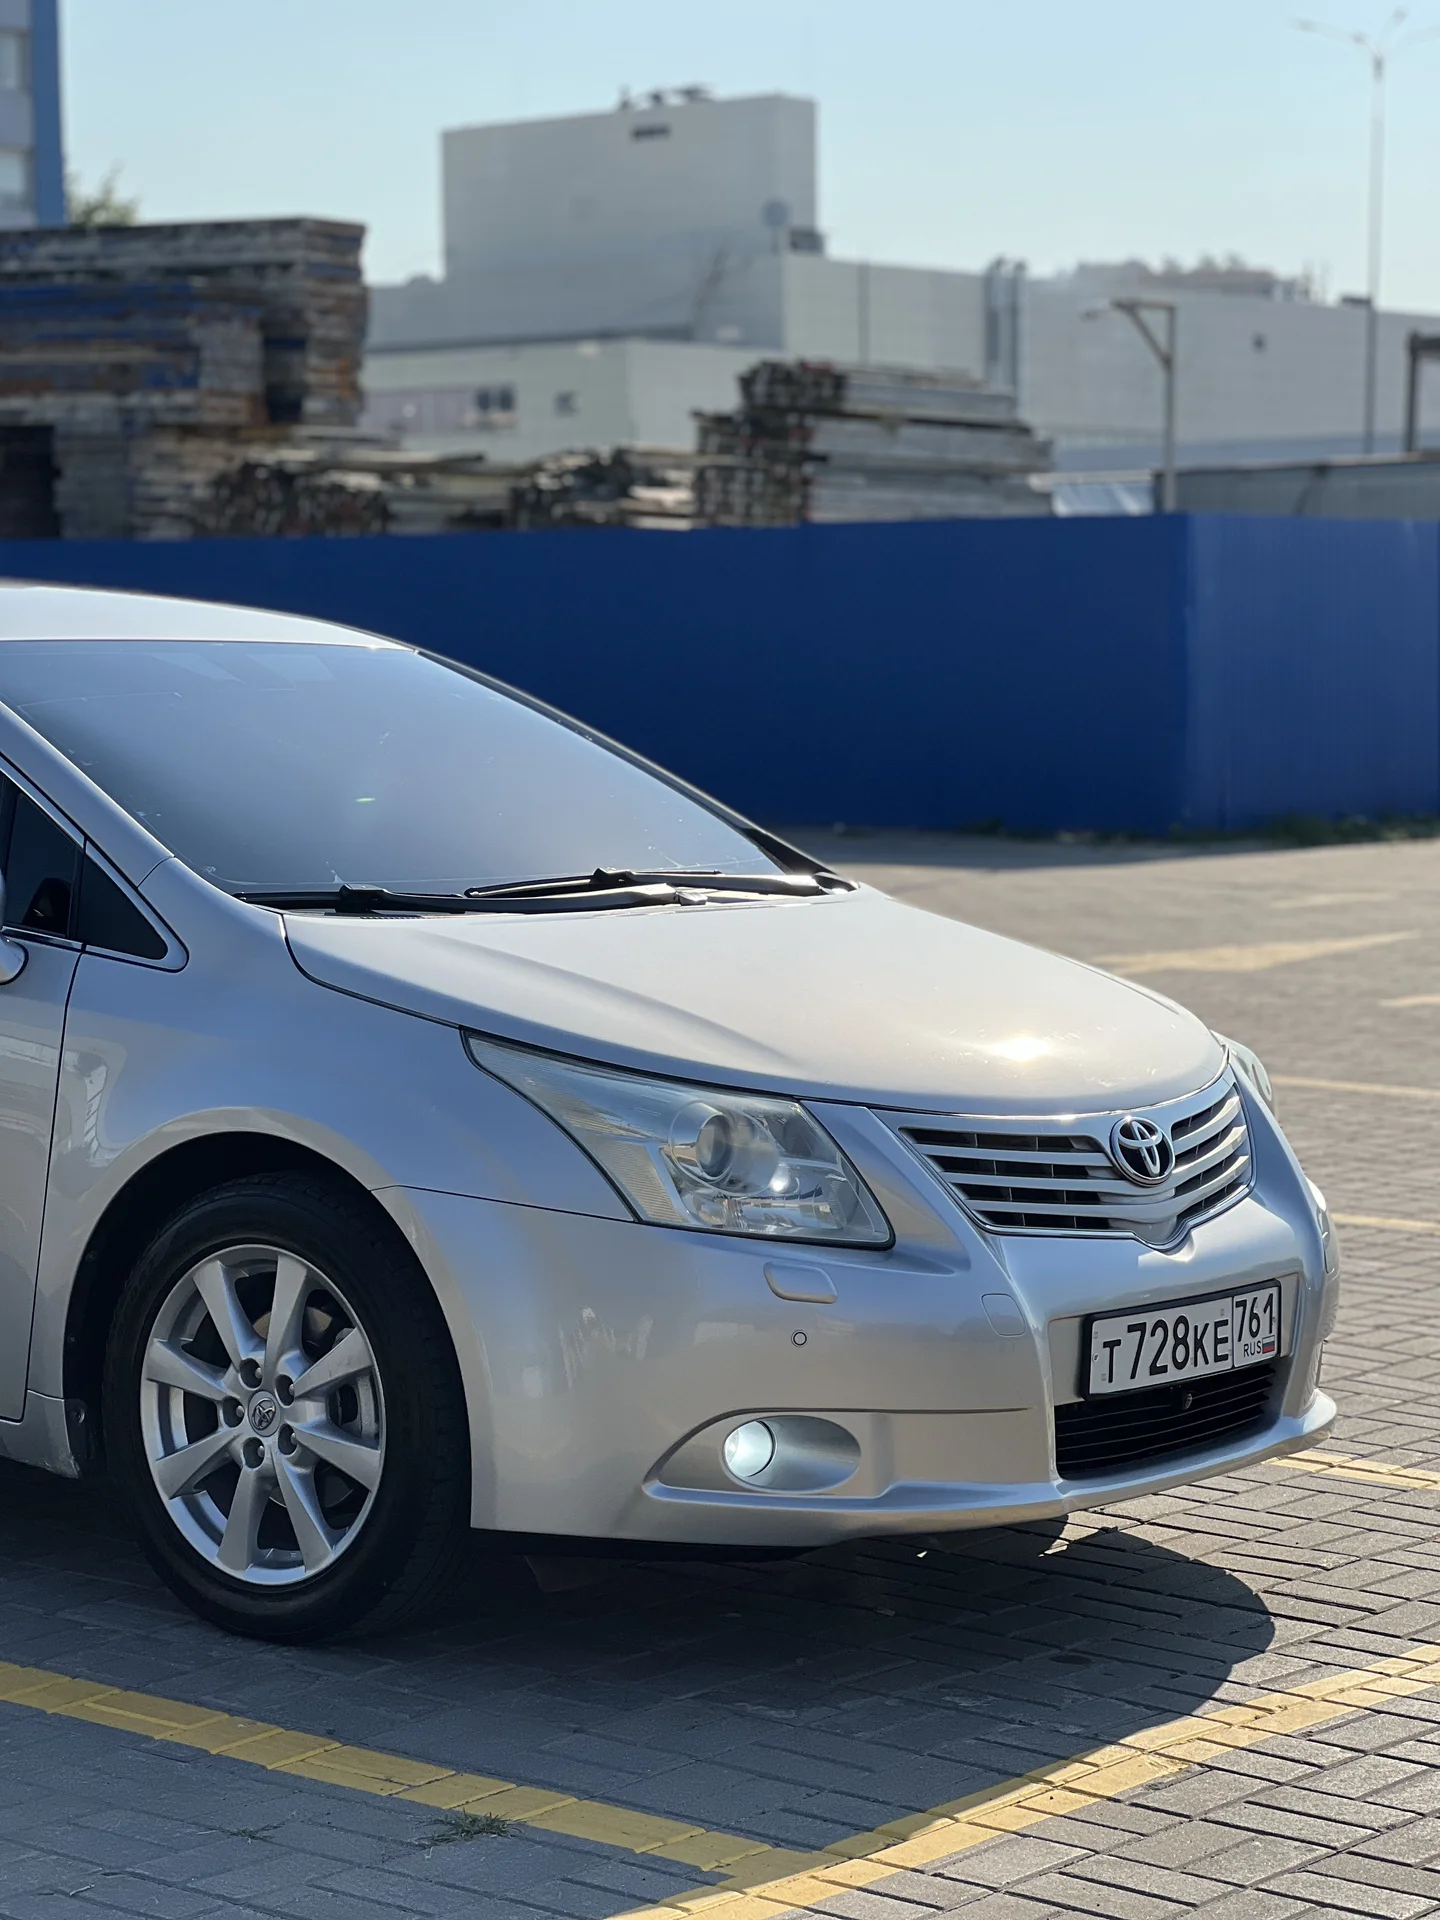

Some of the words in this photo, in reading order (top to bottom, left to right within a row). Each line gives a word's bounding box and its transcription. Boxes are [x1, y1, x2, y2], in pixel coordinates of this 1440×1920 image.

[1102, 1315, 1229, 1383] T728KE
[1235, 1293, 1274, 1342] 761
[1243, 1341, 1262, 1357] RUS
